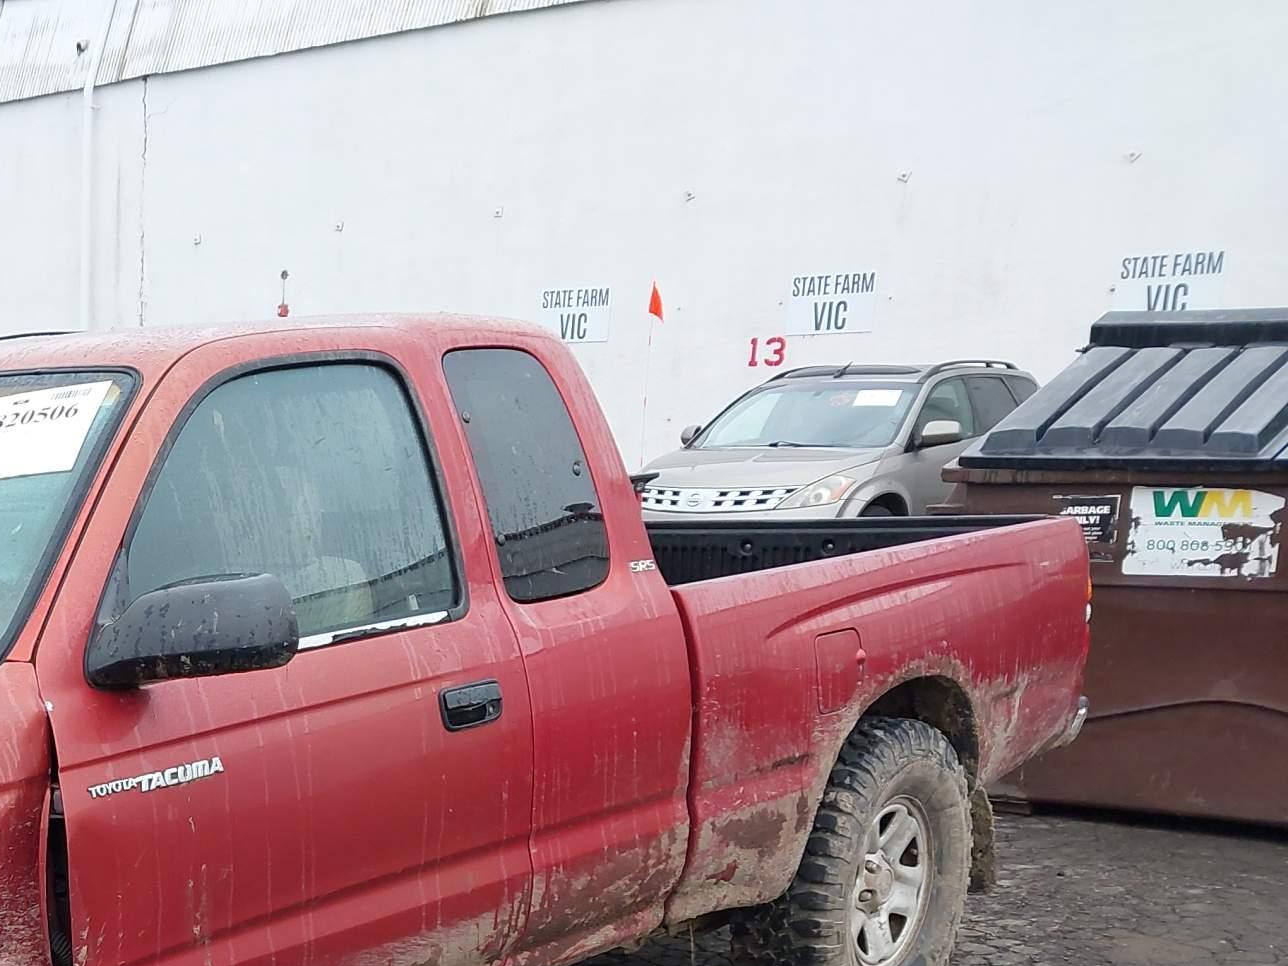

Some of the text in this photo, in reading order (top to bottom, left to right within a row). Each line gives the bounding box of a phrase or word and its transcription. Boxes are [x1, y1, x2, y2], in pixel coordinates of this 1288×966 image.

[1120, 251, 1225, 280] STATE FARM
[542, 287, 610, 309] STATE FARM
[792, 272, 876, 297] STATE FARM
[1146, 283, 1190, 312] VIC
[560, 312, 588, 340] VIC
[814, 300, 848, 331] VIC
[748, 336, 787, 367] 13
[1152, 490, 1253, 518] WM
[88, 779, 137, 798] TOYOTA
